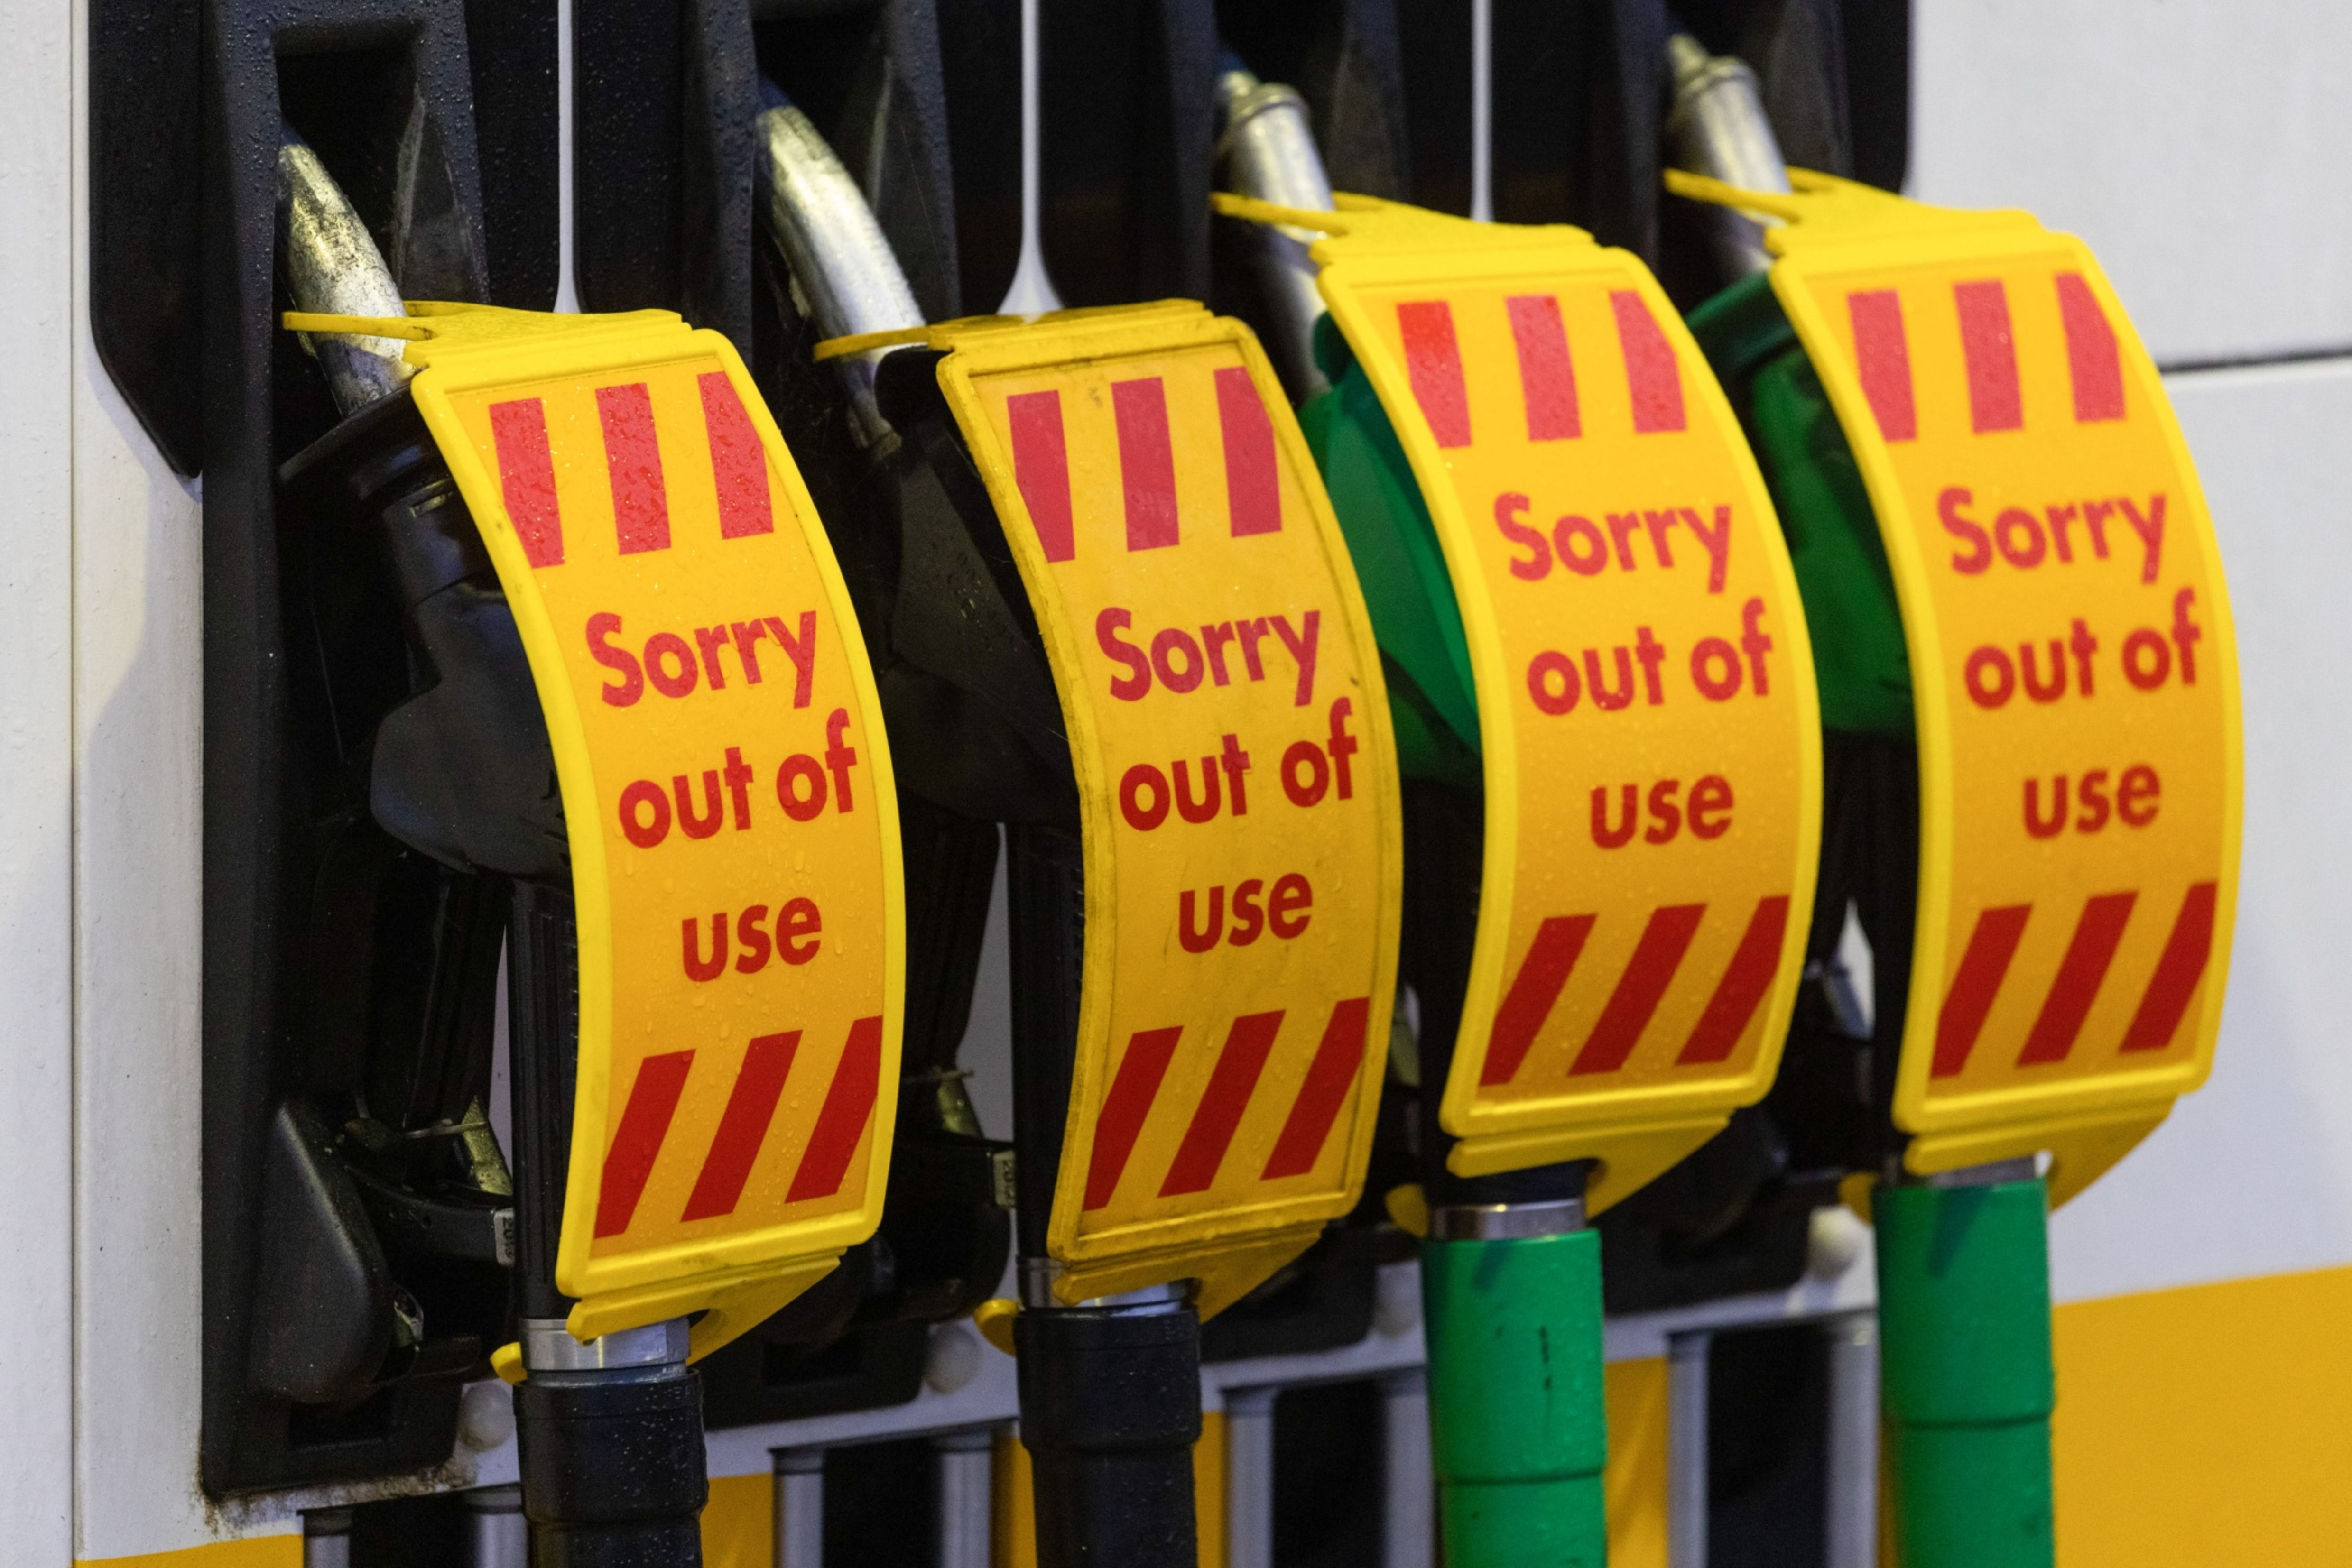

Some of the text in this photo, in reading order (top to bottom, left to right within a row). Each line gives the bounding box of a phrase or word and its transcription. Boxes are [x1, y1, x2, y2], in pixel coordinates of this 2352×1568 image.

[1494, 493, 1730, 593] Sorry
[1938, 488, 2166, 583] Sorry
[585, 610, 817, 709] Sorry
[1095, 607, 1320, 707] Sorry
[1527, 598, 1772, 716] out of
[1964, 587, 2201, 710] out of
[618, 708, 858, 849] out of
[1119, 696, 1358, 832] out of
[1590, 774, 1734, 850] use
[2023, 764, 2161, 840] use
[681, 896, 823, 983] use
[1178, 872, 1313, 954] use
